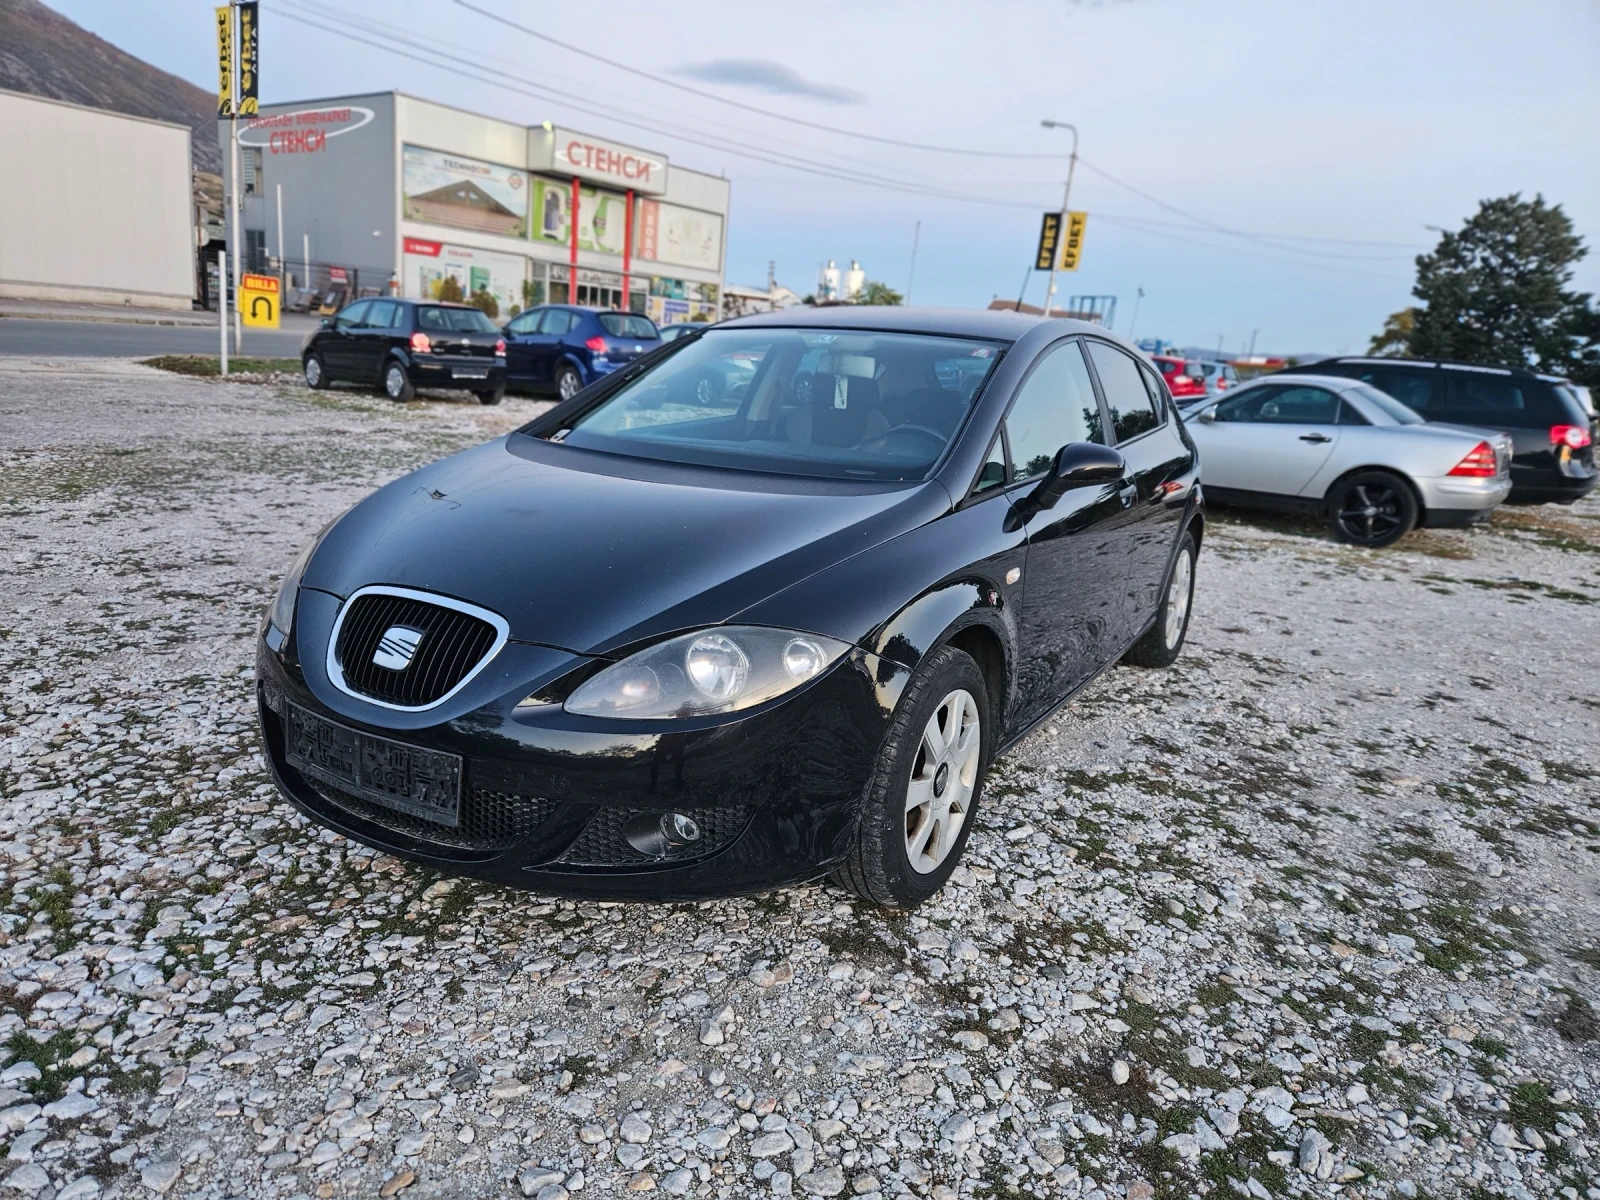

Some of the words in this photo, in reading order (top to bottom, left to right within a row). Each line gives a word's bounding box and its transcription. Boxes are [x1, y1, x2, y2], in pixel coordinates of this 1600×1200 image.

[270, 129, 327, 154] СТЕНСИ
[566, 140, 651, 183] СТЕНСИ
[1063, 216, 1082, 268] EFBET
[246, 277, 278, 291] BILLA
